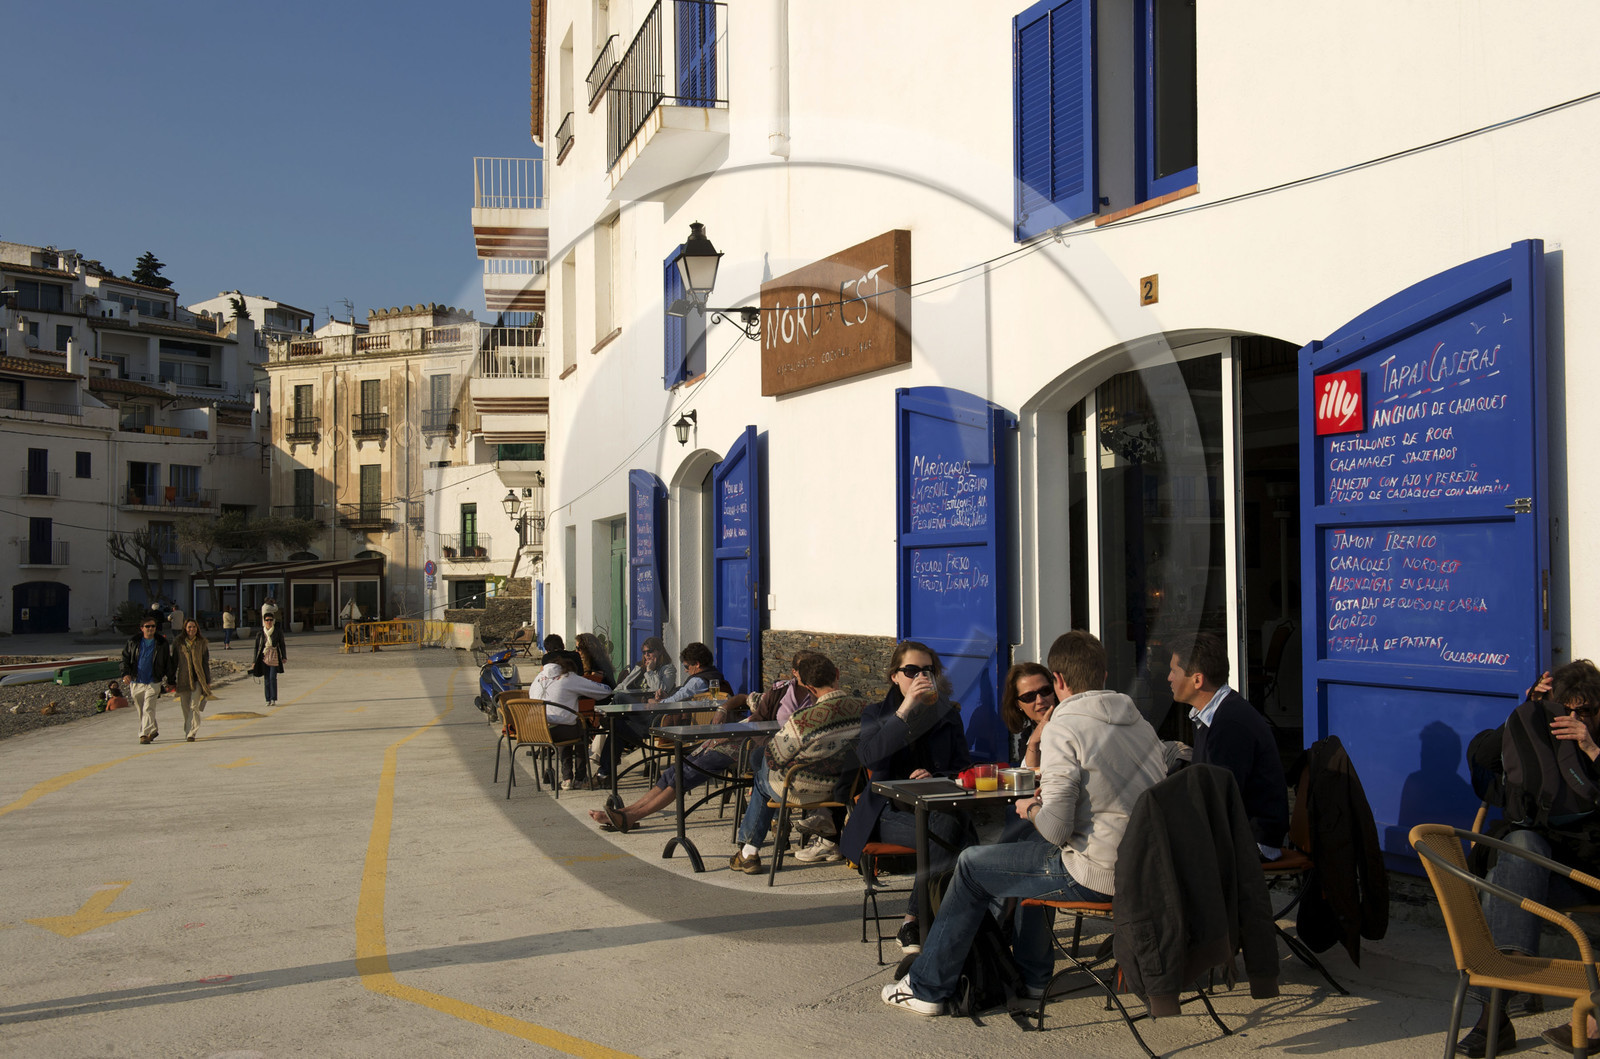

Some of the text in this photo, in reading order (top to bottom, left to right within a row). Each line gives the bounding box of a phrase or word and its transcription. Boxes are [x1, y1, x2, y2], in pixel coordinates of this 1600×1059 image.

[1144, 280, 1153, 301] 2
[766, 264, 889, 350] NORD EST
[1380, 341, 1501, 393] TAPAS CASERAS
[1318, 379, 1359, 427] illy
[1372, 394, 1507, 429] ANCHOAS DE CADAQUES
[1330, 433, 1396, 453] MEJILLONES
[1402, 432, 1419, 446] DE
[1330, 446, 1458, 473] CALAMARES SALTEADOS
[1379, 476, 1398, 488] CON
[1402, 474, 1421, 487] AJO
[1425, 473, 1434, 487] Y
[1330, 490, 1364, 504] PULPO
[1368, 490, 1382, 500] DE
[1386, 487, 1442, 499] CADAQUES
[1444, 488, 1465, 497] CON
[1332, 530, 1437, 552] JAMON IBERICO
[1330, 556, 1462, 574] CARACOLES NORD-EST
[1400, 578, 1416, 590] EN
[1329, 596, 1380, 611] TOSTADAS
[1382, 597, 1397, 608] DE
[1397, 597, 1432, 611] QUESO
[1433, 599, 1446, 611] DE
[1329, 611, 1378, 631] CHORIZO
[1383, 638, 1399, 650] DE
[1400, 636, 1444, 649] PATATAS
